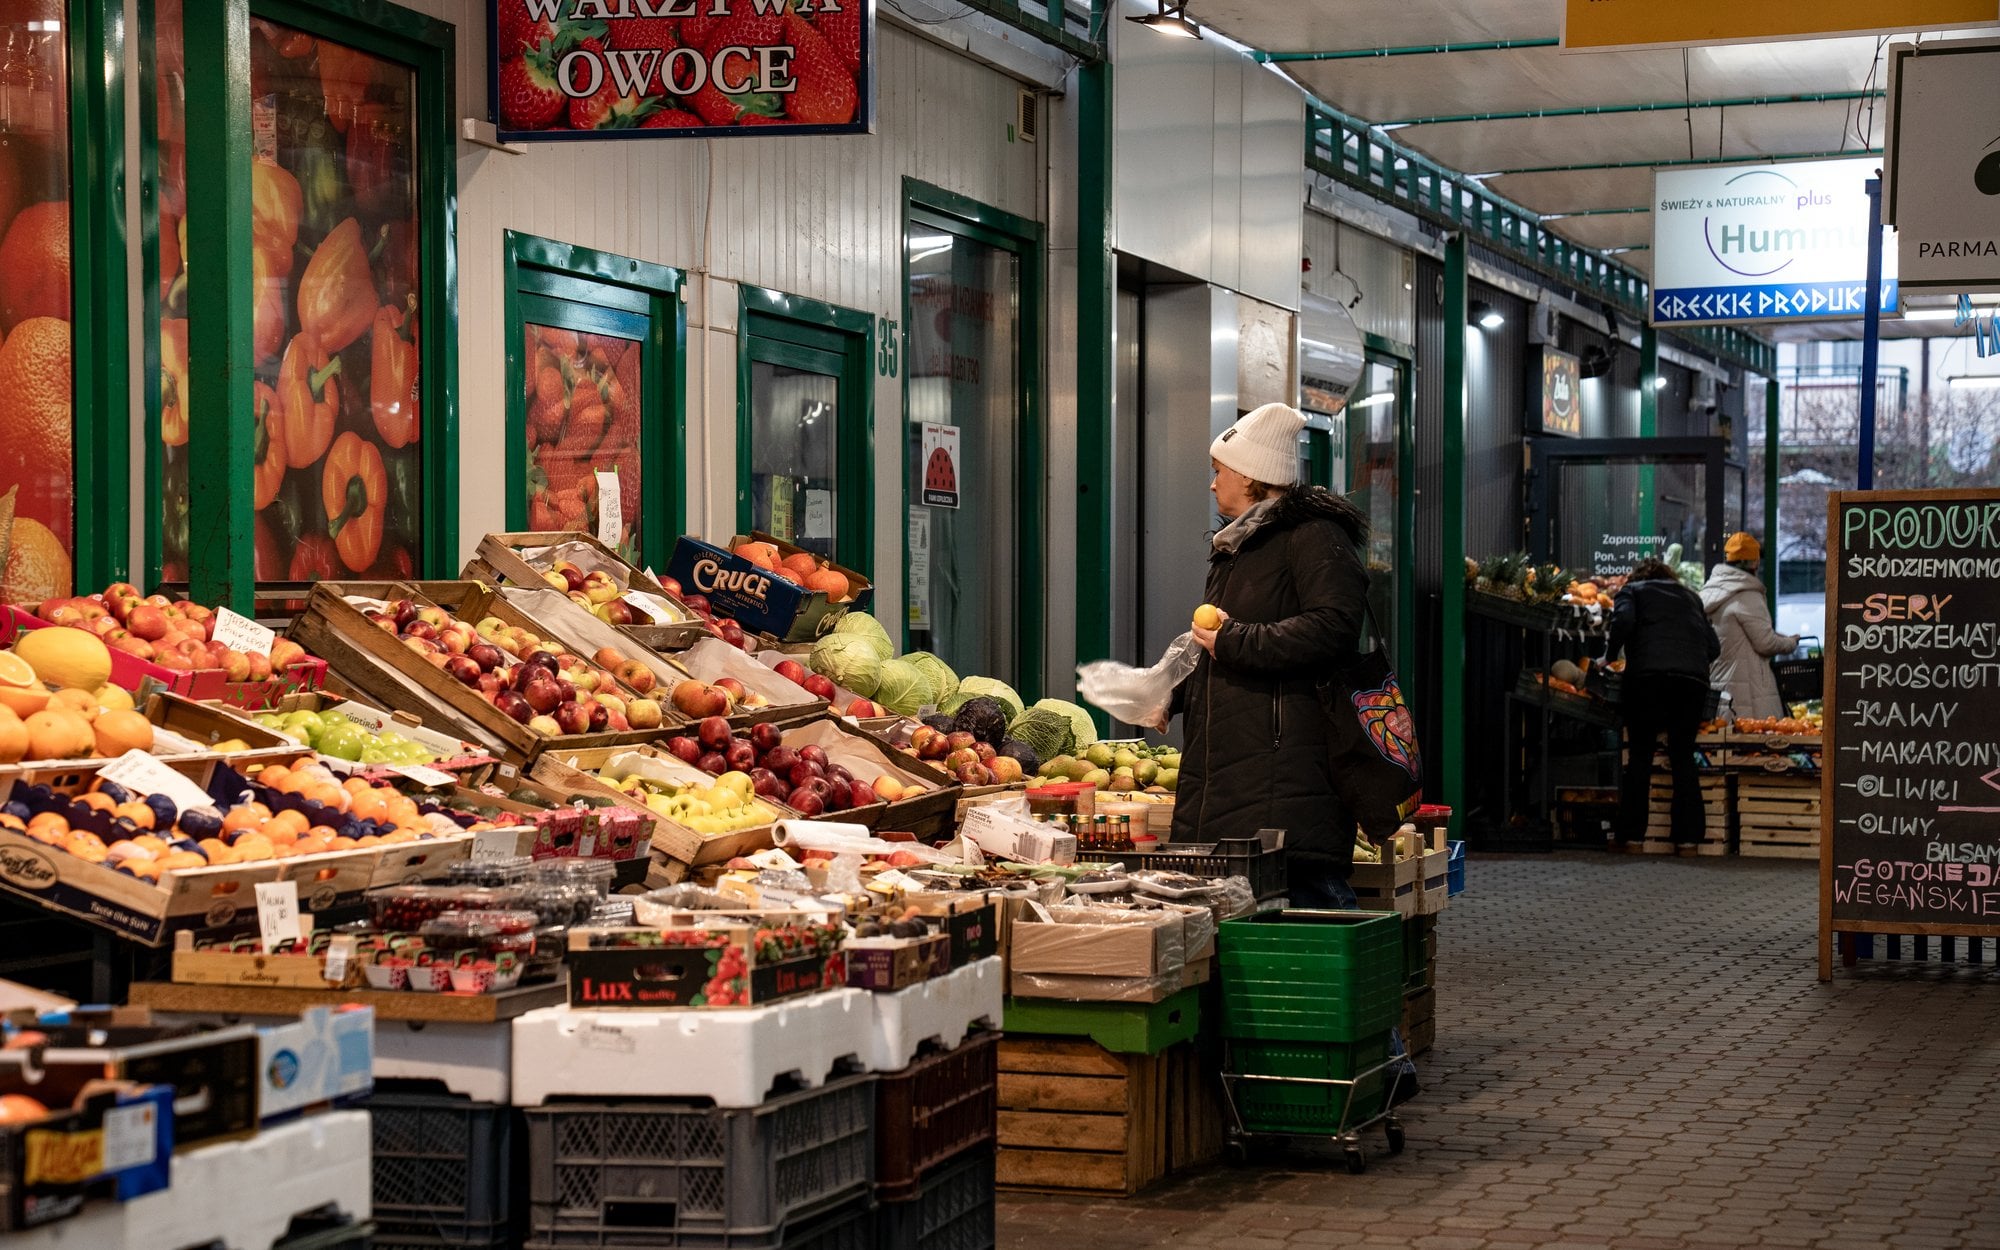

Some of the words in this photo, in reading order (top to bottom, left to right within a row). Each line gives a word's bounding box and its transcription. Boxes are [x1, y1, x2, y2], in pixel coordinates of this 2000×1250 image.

[557, 46, 798, 97] OWOCE
[1660, 198, 1703, 211] ŚWIEŻY
[1716, 195, 1786, 209] NATURALNY
[1796, 189, 1832, 210] plus
[1919, 240, 1998, 258] PARMA
[1656, 291, 1753, 319] GRECKIE
[1758, 284, 1892, 315] PRODUKY
[878, 315, 898, 379] 35
[1602, 533, 1667, 547] Zapraszamy
[692, 559, 772, 601] CRUCE
[1841, 622, 2000, 659] DOJRZEWAJ
[1834, 877, 2000, 917] WEGAŃSKIE
[582, 977, 634, 1001] Lux
